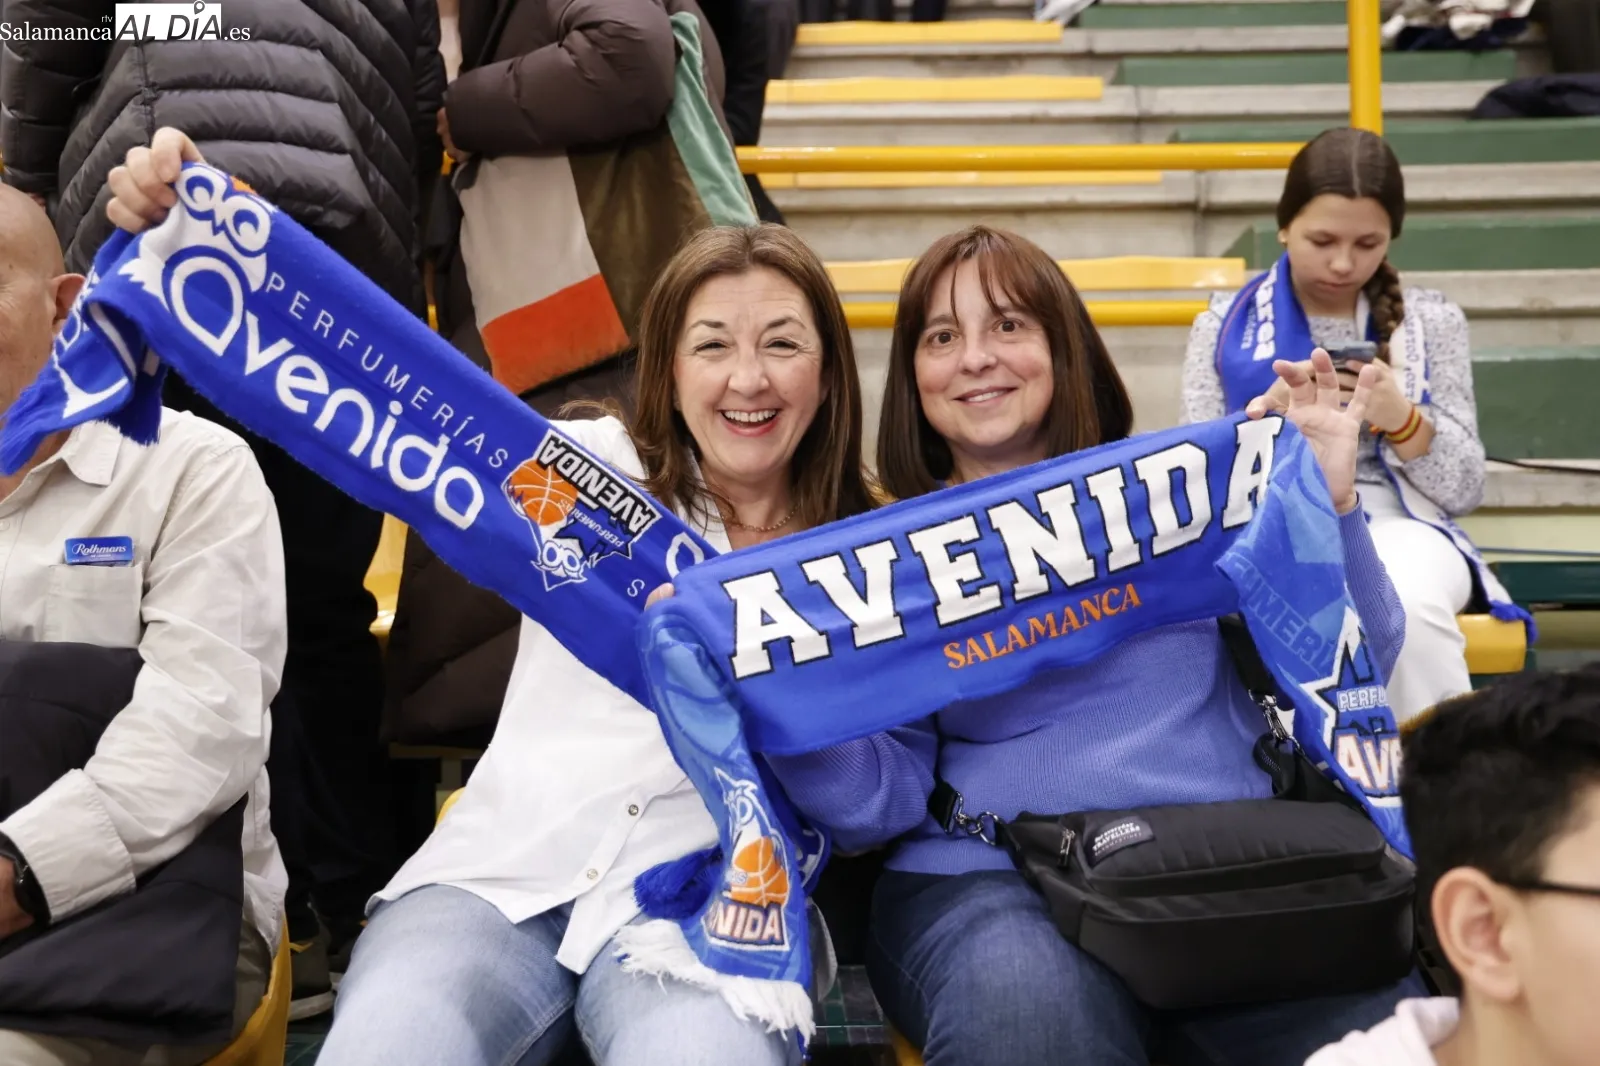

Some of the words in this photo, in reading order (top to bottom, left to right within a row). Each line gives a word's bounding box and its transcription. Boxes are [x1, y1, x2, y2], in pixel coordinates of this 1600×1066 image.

[266, 271, 509, 469] PERFUMERÍAS
[537, 437, 652, 534] AVENIDA
[72, 542, 126, 556] Rothmans
[722, 415, 1285, 680] AVENIDA
[943, 584, 1143, 670] SALAMANCA
[709, 902, 781, 941] NIDA
